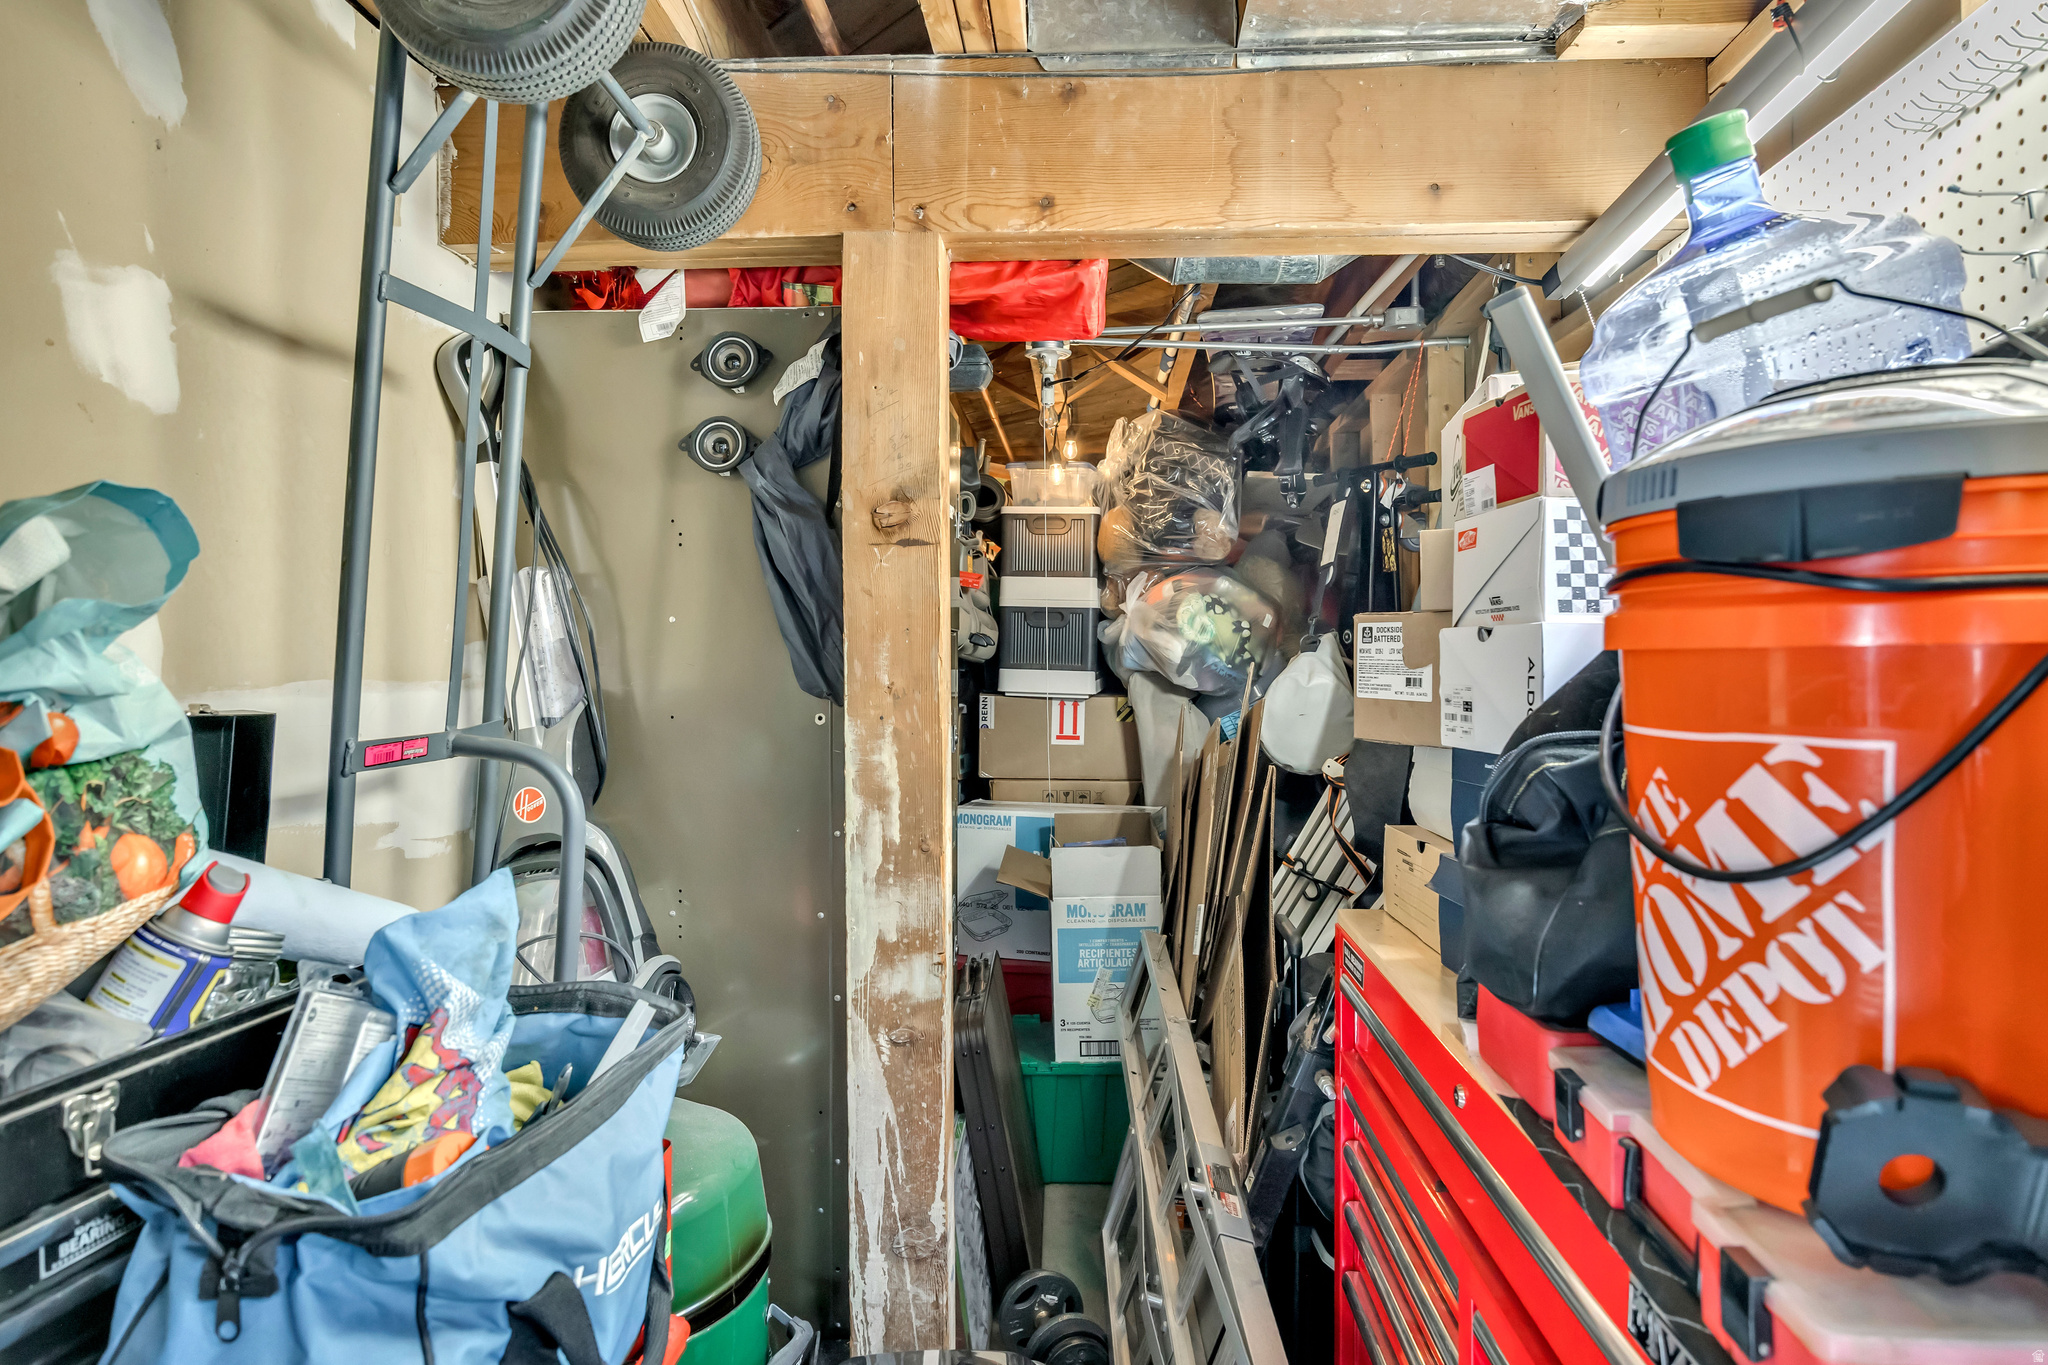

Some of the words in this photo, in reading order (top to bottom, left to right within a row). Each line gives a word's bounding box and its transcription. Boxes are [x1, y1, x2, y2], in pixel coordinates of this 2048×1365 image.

[1512, 399, 1536, 421] VANS
[1373, 635, 1401, 643] BATTERED
[1079, 948, 1137, 958] RECIPIENTES
[1670, 890, 1888, 1091] DEPOT
[1060, 1019, 1066, 1027] 3
